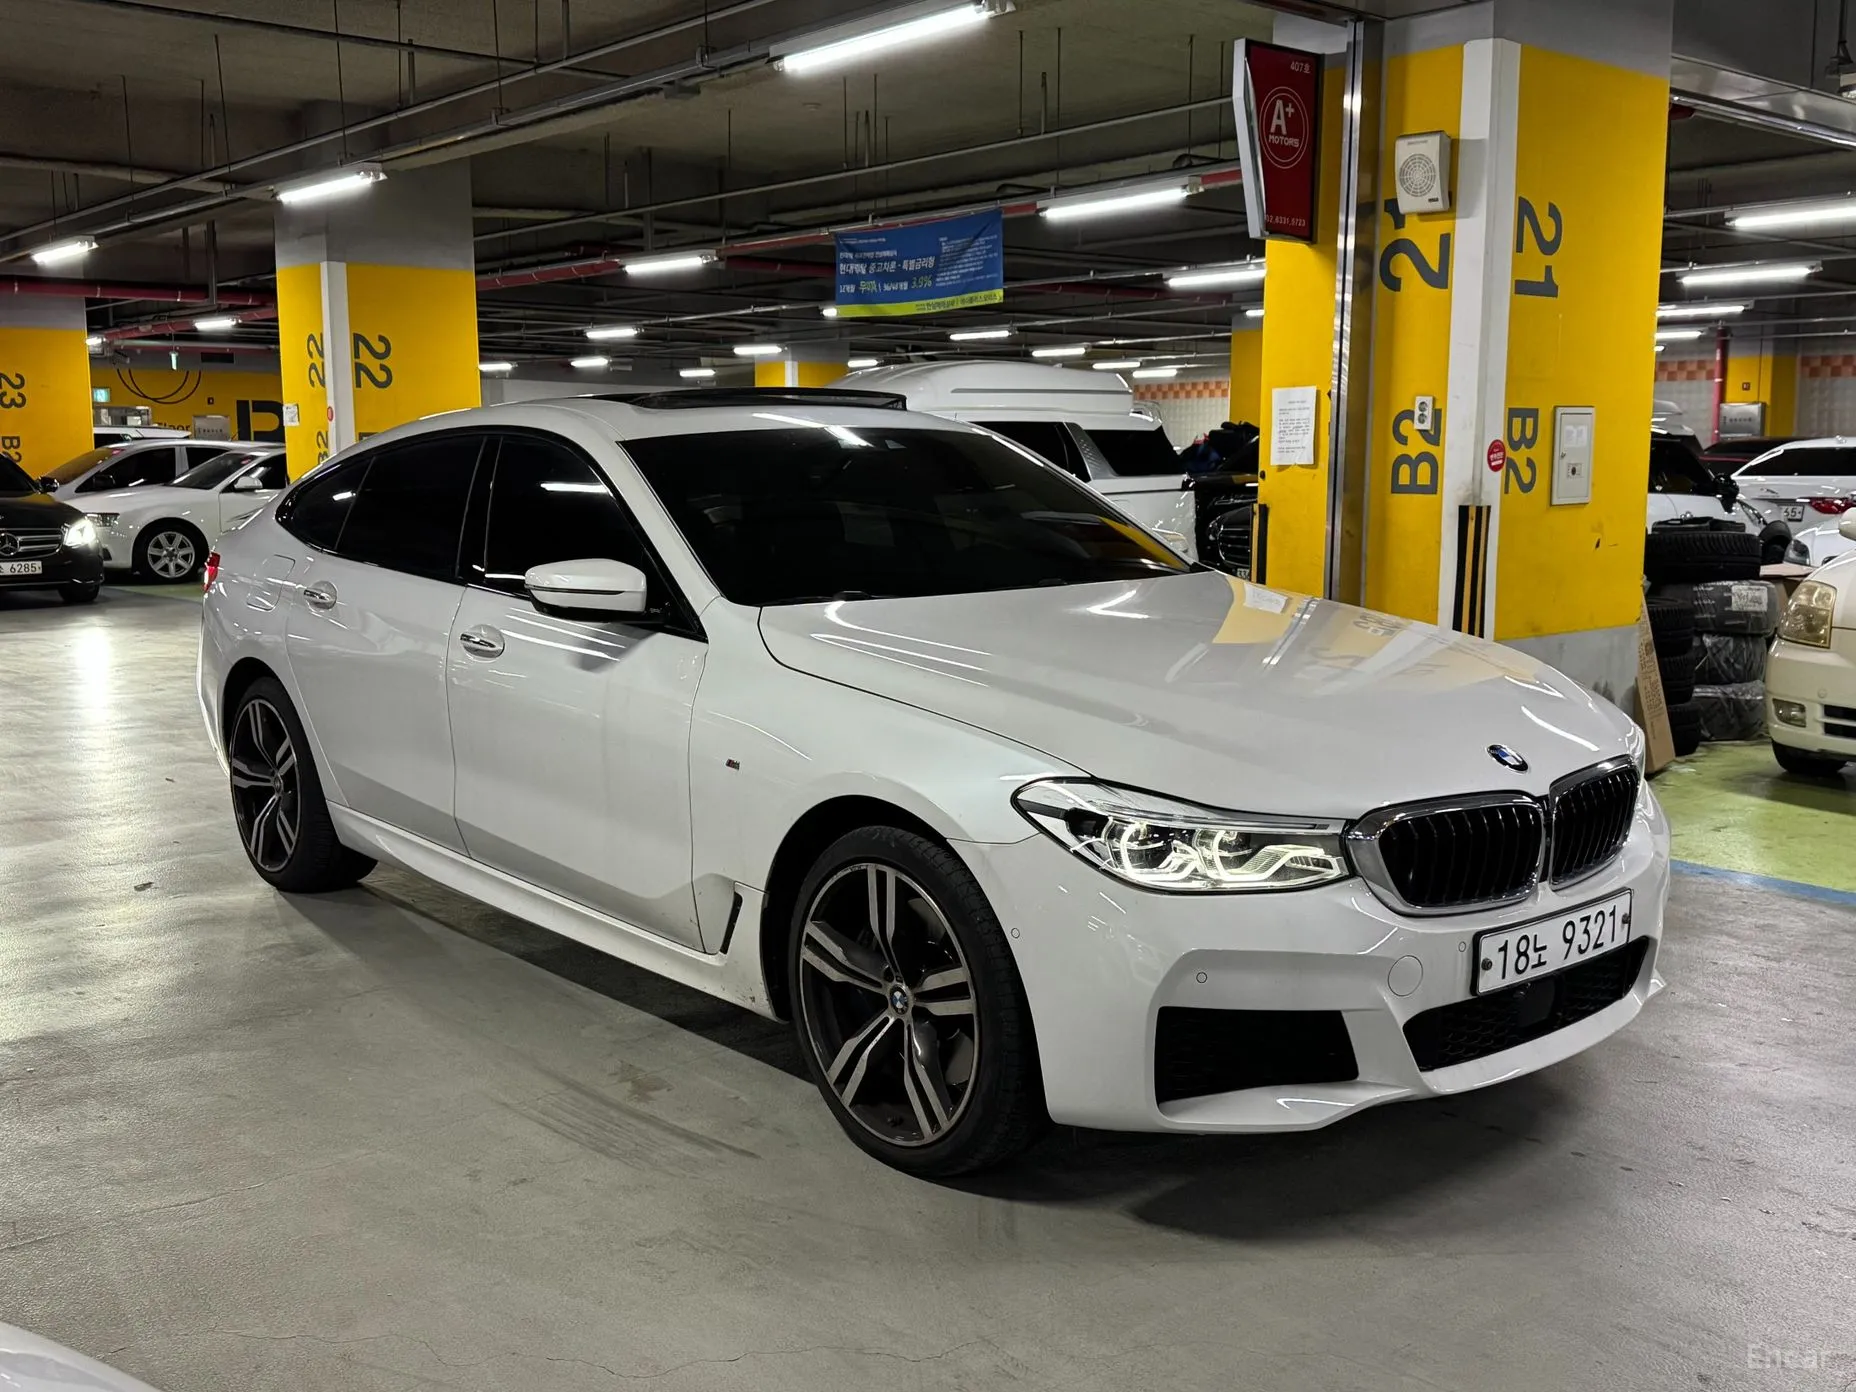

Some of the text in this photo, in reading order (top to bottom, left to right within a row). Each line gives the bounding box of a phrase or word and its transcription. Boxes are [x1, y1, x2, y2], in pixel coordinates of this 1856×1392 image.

[1268, 134, 1300, 148] MOTORS
[1514, 195, 1563, 298] 21
[307, 332, 326, 388] 22
[353, 332, 393, 389] 22
[0, 372, 27, 409] 23
[1391, 408, 1442, 495] B2
[1504, 407, 1539, 495] B2
[10, 563, 37, 573] 6285
[1498, 905, 1617, 980] 18노 9321
